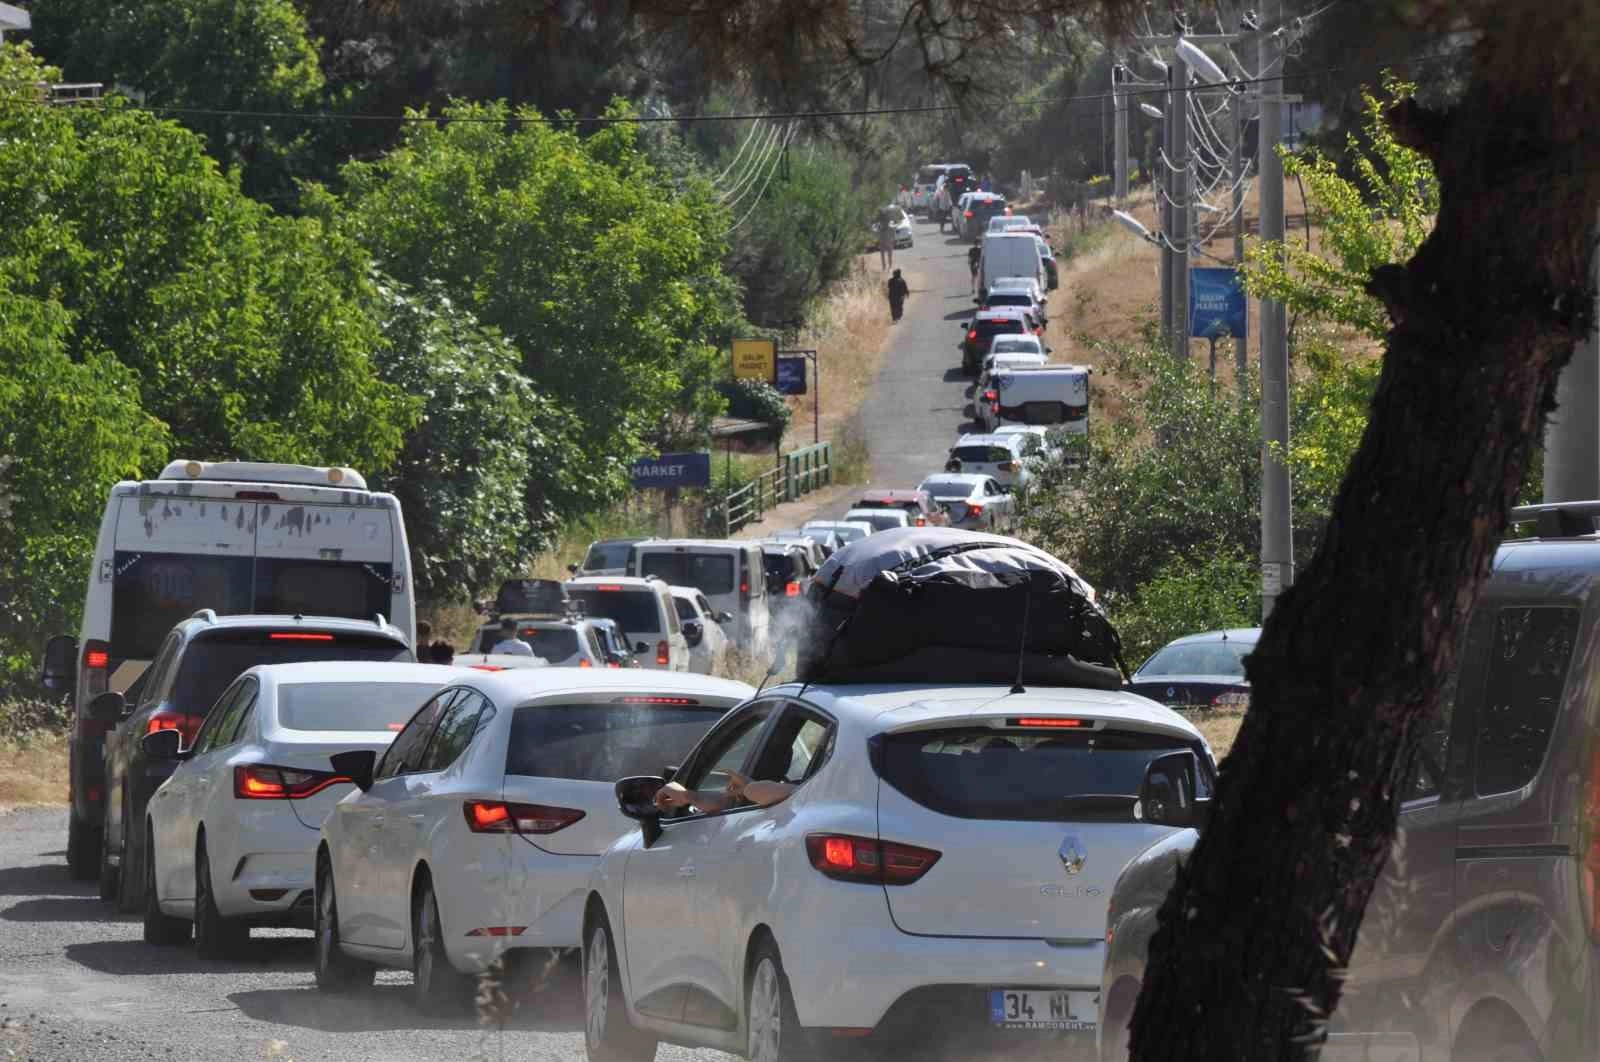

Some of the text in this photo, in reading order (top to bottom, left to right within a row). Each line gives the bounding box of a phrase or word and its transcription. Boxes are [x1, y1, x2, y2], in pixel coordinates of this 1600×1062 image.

[1196, 303, 1230, 311] MARKET
[738, 361, 769, 370] MARKET
[631, 464, 684, 477] MARKET
[1006, 993, 1034, 1020] 34
[1049, 993, 1078, 1020] NL
